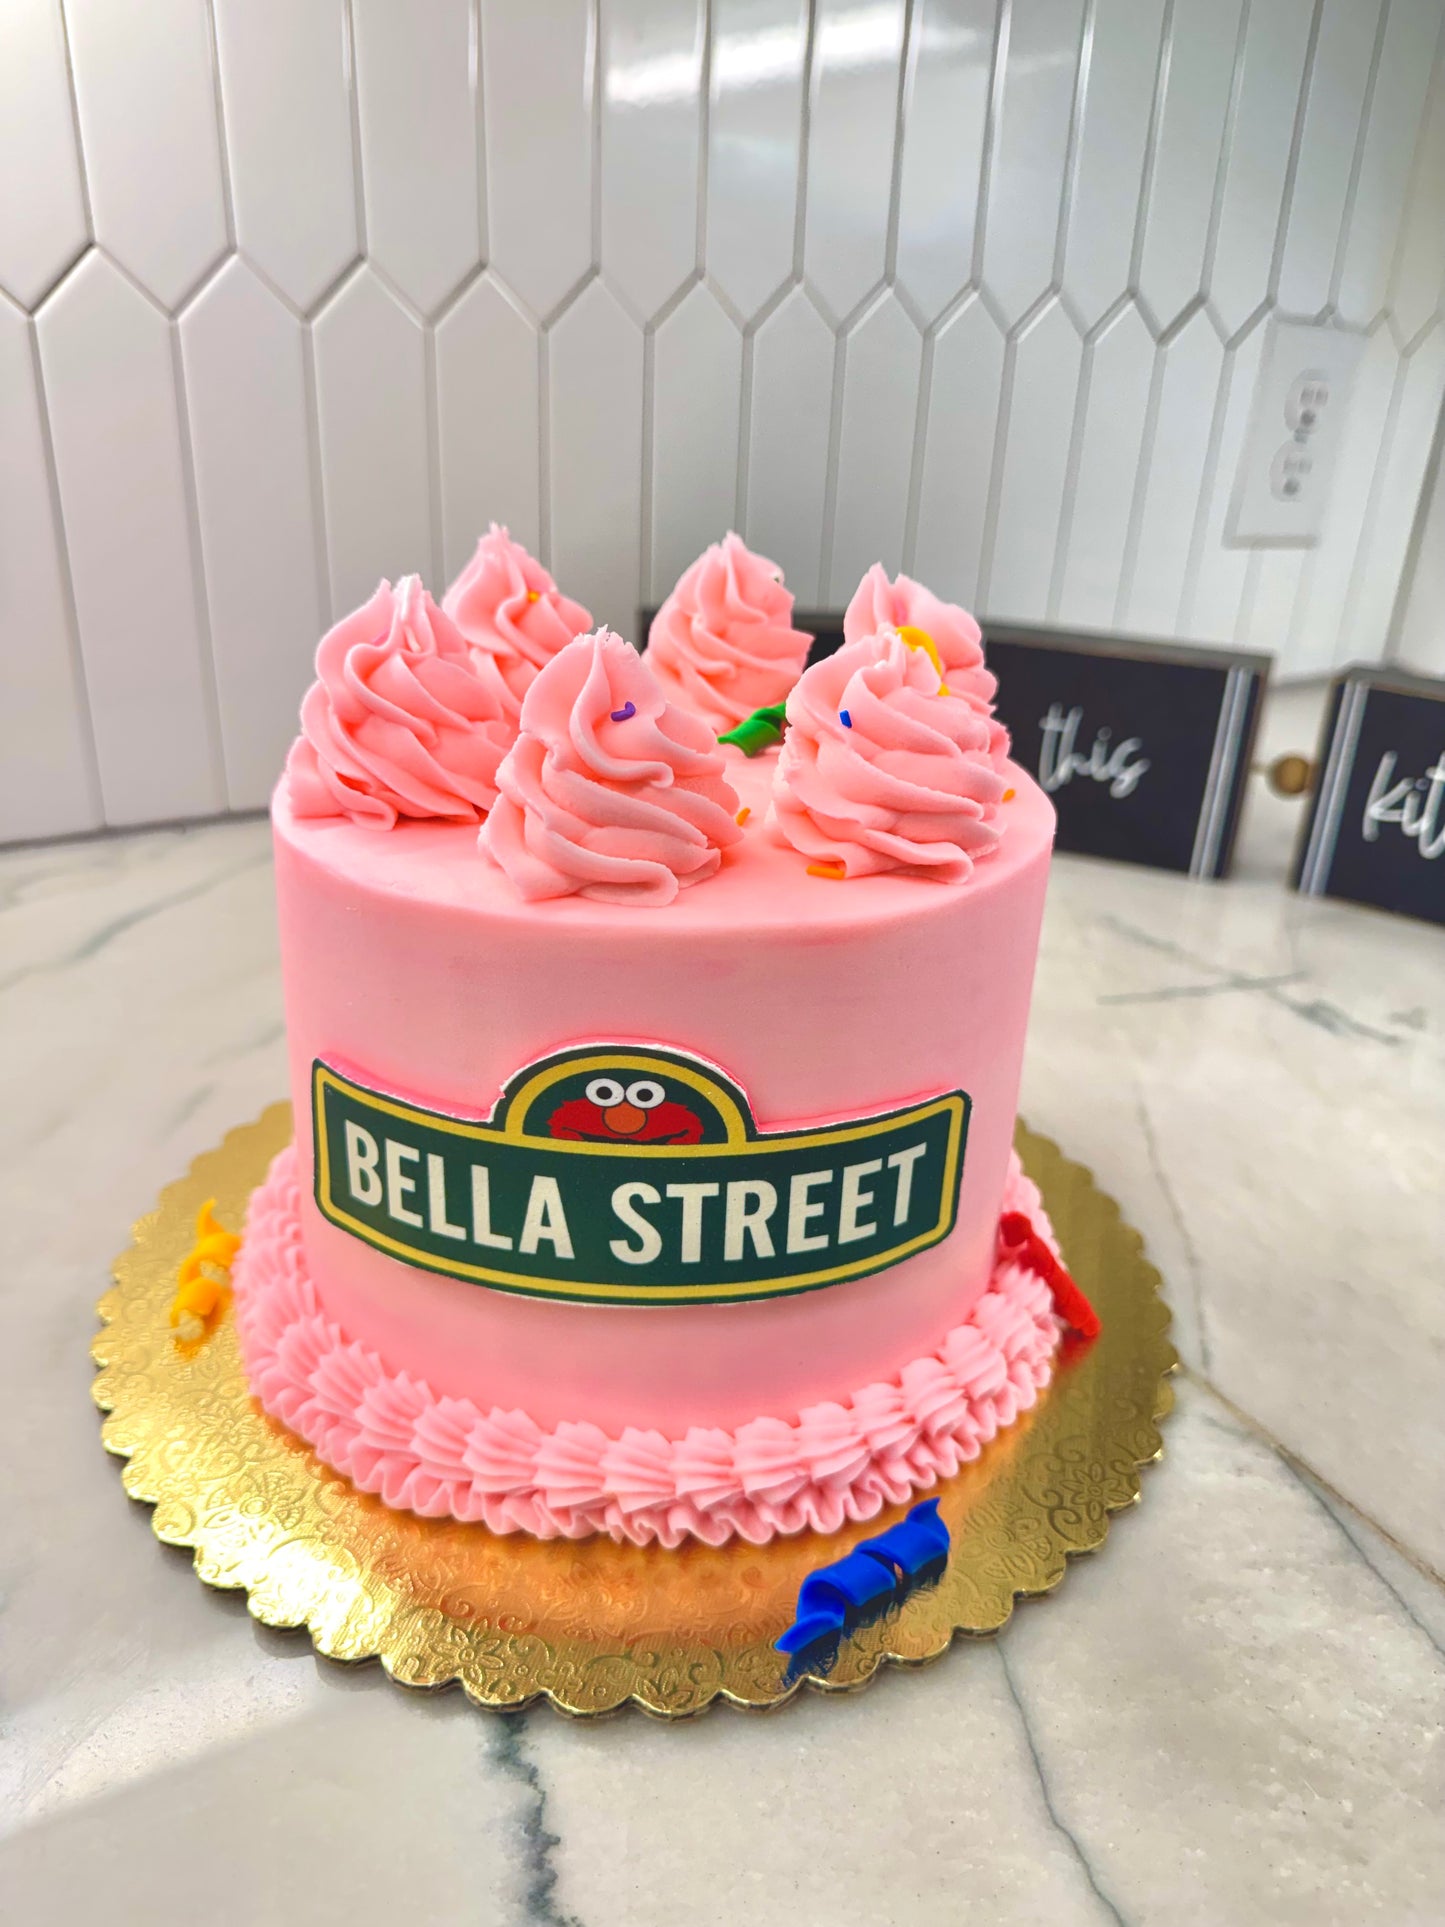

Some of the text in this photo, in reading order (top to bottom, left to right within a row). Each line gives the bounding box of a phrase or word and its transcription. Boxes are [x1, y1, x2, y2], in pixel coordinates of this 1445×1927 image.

[1038, 702, 1151, 799] this
[344, 1119, 927, 1265] BELLA STREET
